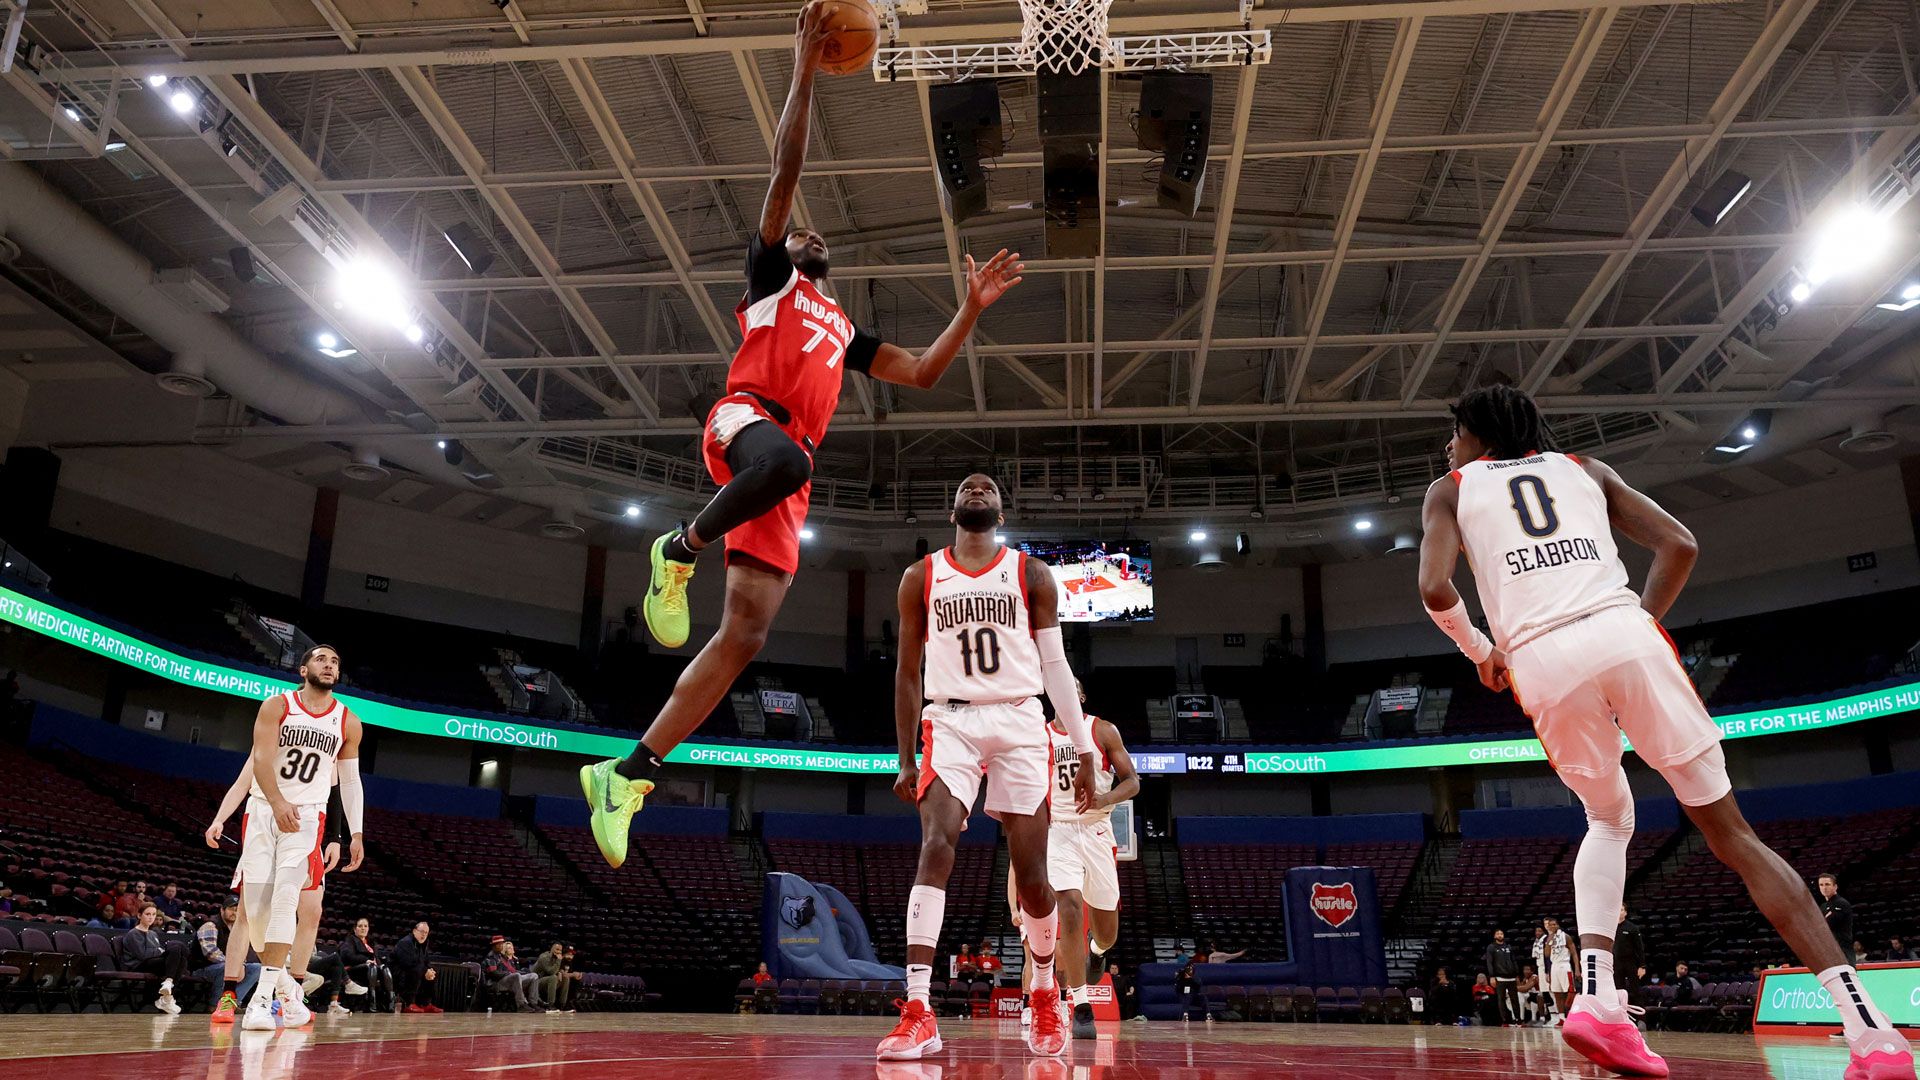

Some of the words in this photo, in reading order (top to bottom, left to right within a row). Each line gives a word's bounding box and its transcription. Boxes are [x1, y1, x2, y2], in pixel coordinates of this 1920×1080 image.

[802, 319, 844, 369] 77
[1507, 474, 1560, 539] 0
[1505, 538, 1601, 576] SEABRON
[367, 578, 388, 589] 209
[942, 590, 1007, 602] BIRMINGHAM
[934, 595, 1017, 632] SQUADRON
[25, 607, 90, 643] MEDICINE
[91, 632, 142, 663] PARTNER
[144, 652, 168, 672] FOR
[169, 660, 192, 680] THE
[194, 669, 261, 695] MEMPHIS
[957, 627, 1001, 677] 10
[1750, 717, 1785, 731] FOR
[1788, 710, 1822, 727] THE
[1826, 696, 1893, 721] MEMPHIS
[1895, 690, 1920, 707] HU
[279, 725, 339, 758] SQUADRON
[445, 718, 558, 748] OrthoSouth
[280, 748, 321, 784] 30
[690, 749, 751, 763] OFFICIAL
[753, 753, 803, 766] SPORTS
[805, 757, 870, 769] MEDICINE
[1187, 756, 1213, 770] 10:22
[1224, 755, 1238, 764] 4TH
[1469, 746, 1538, 760] OFFICIAL
[1315, 897, 1353, 910] hustle
